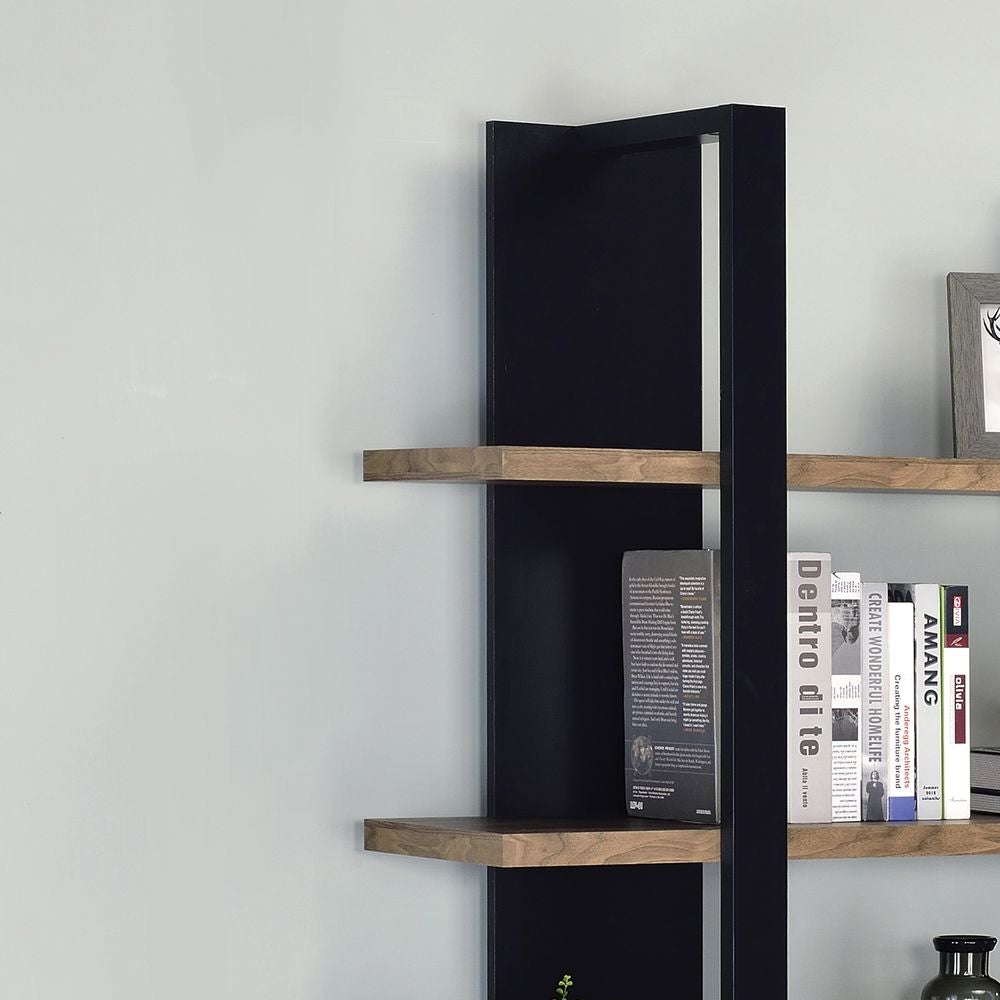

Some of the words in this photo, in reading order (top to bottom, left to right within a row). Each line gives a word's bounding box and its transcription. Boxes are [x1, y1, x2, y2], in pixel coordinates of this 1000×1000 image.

[798, 560, 822, 668] Dentro
[868, 593, 882, 632] CREATE
[868, 636, 882, 704] WONDERFUL
[924, 613, 939, 706] AMANG
[799, 685, 823, 715] di
[893, 674, 901, 710] Creating
[954, 676, 965, 710] olivia
[799, 726, 823, 756] te
[868, 708, 882, 763] HOMELIFE
[903, 705, 911, 745] Anderegg
[894, 765, 902, 789] brand
